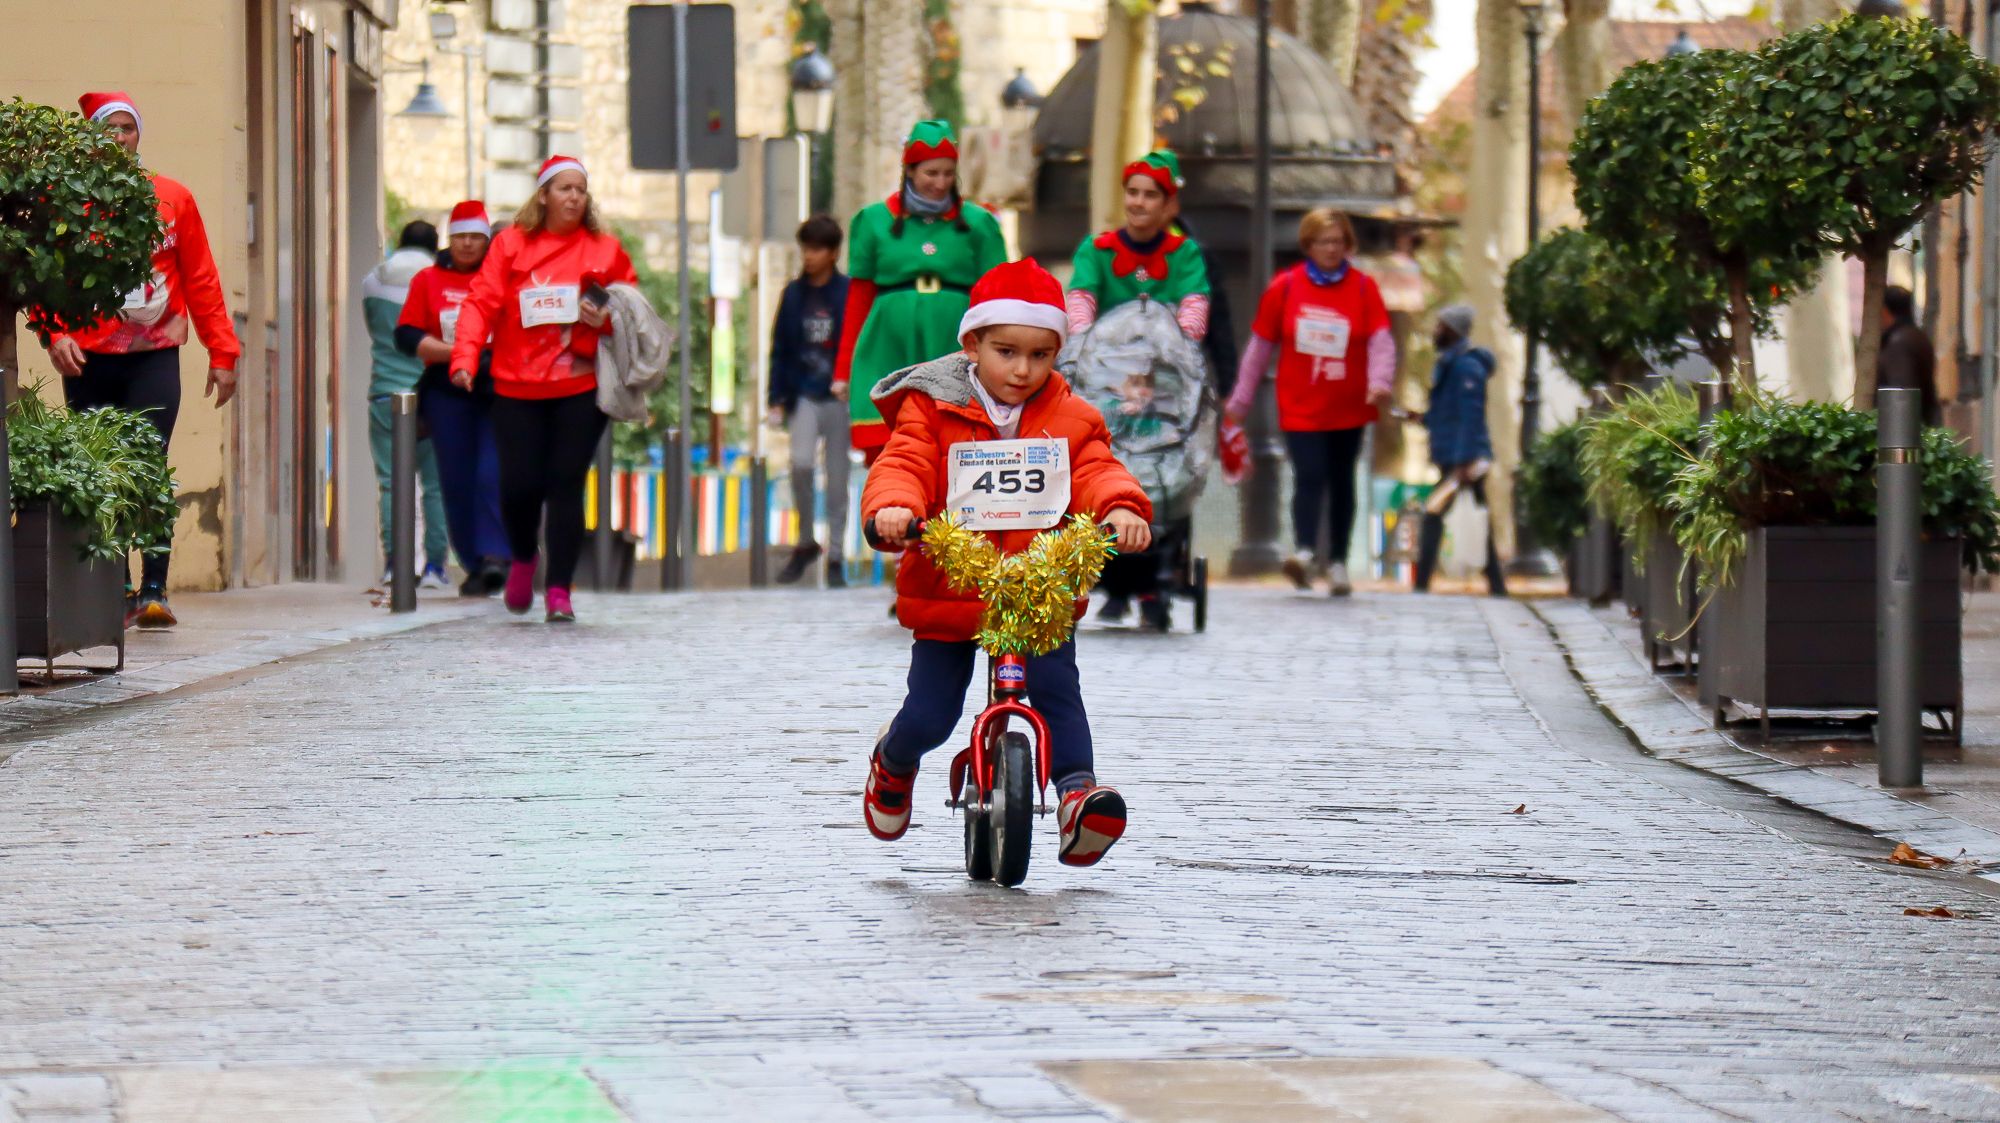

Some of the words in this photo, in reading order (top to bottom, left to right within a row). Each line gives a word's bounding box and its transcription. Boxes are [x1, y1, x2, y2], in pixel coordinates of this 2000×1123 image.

[531, 297, 565, 308] 451
[975, 451, 1006, 459] Silvestro
[972, 469, 1046, 494] 453
